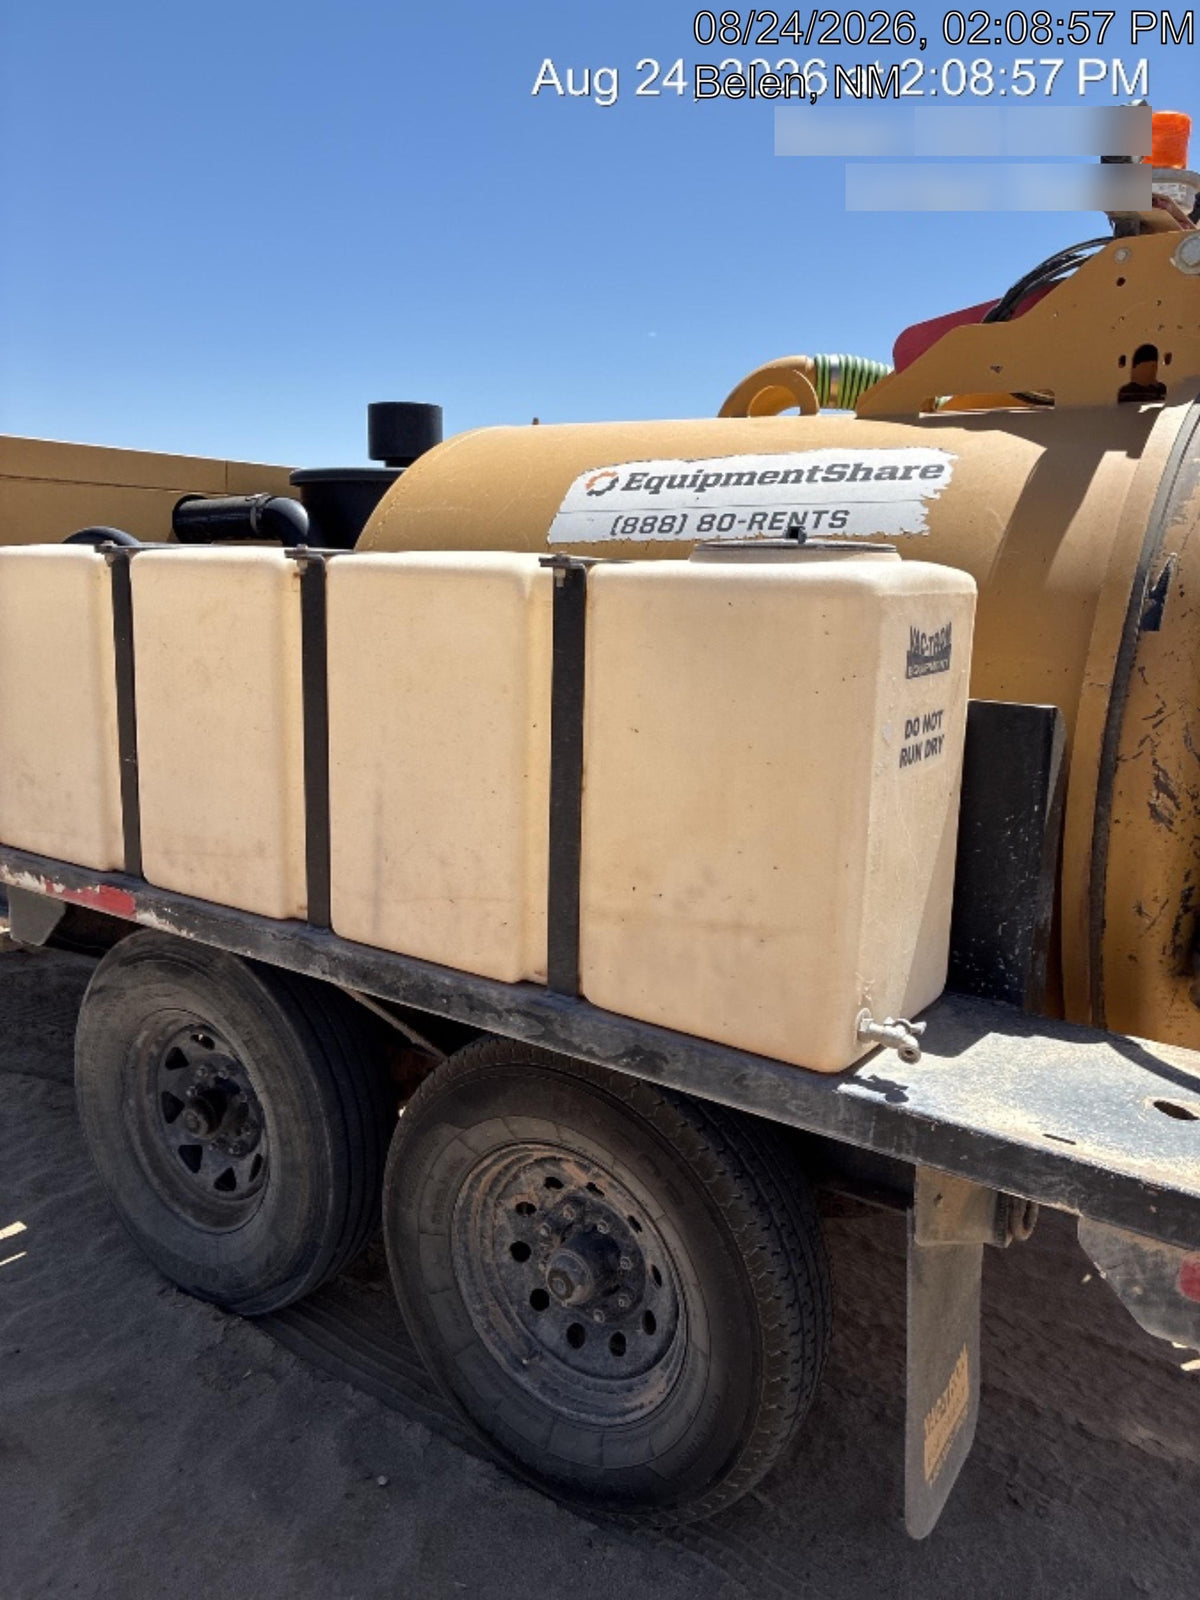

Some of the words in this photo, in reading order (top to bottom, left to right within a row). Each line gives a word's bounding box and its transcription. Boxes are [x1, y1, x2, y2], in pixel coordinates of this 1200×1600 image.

[620, 462, 946, 496] EquipmentShare
[610, 513, 689, 537] (888)
[696, 509, 850, 533] 80-RENTS
[904, 716, 920, 740] DO
[922, 709, 944, 734] NOT
[899, 741, 923, 768] RUN
[924, 734, 945, 759] DRY
